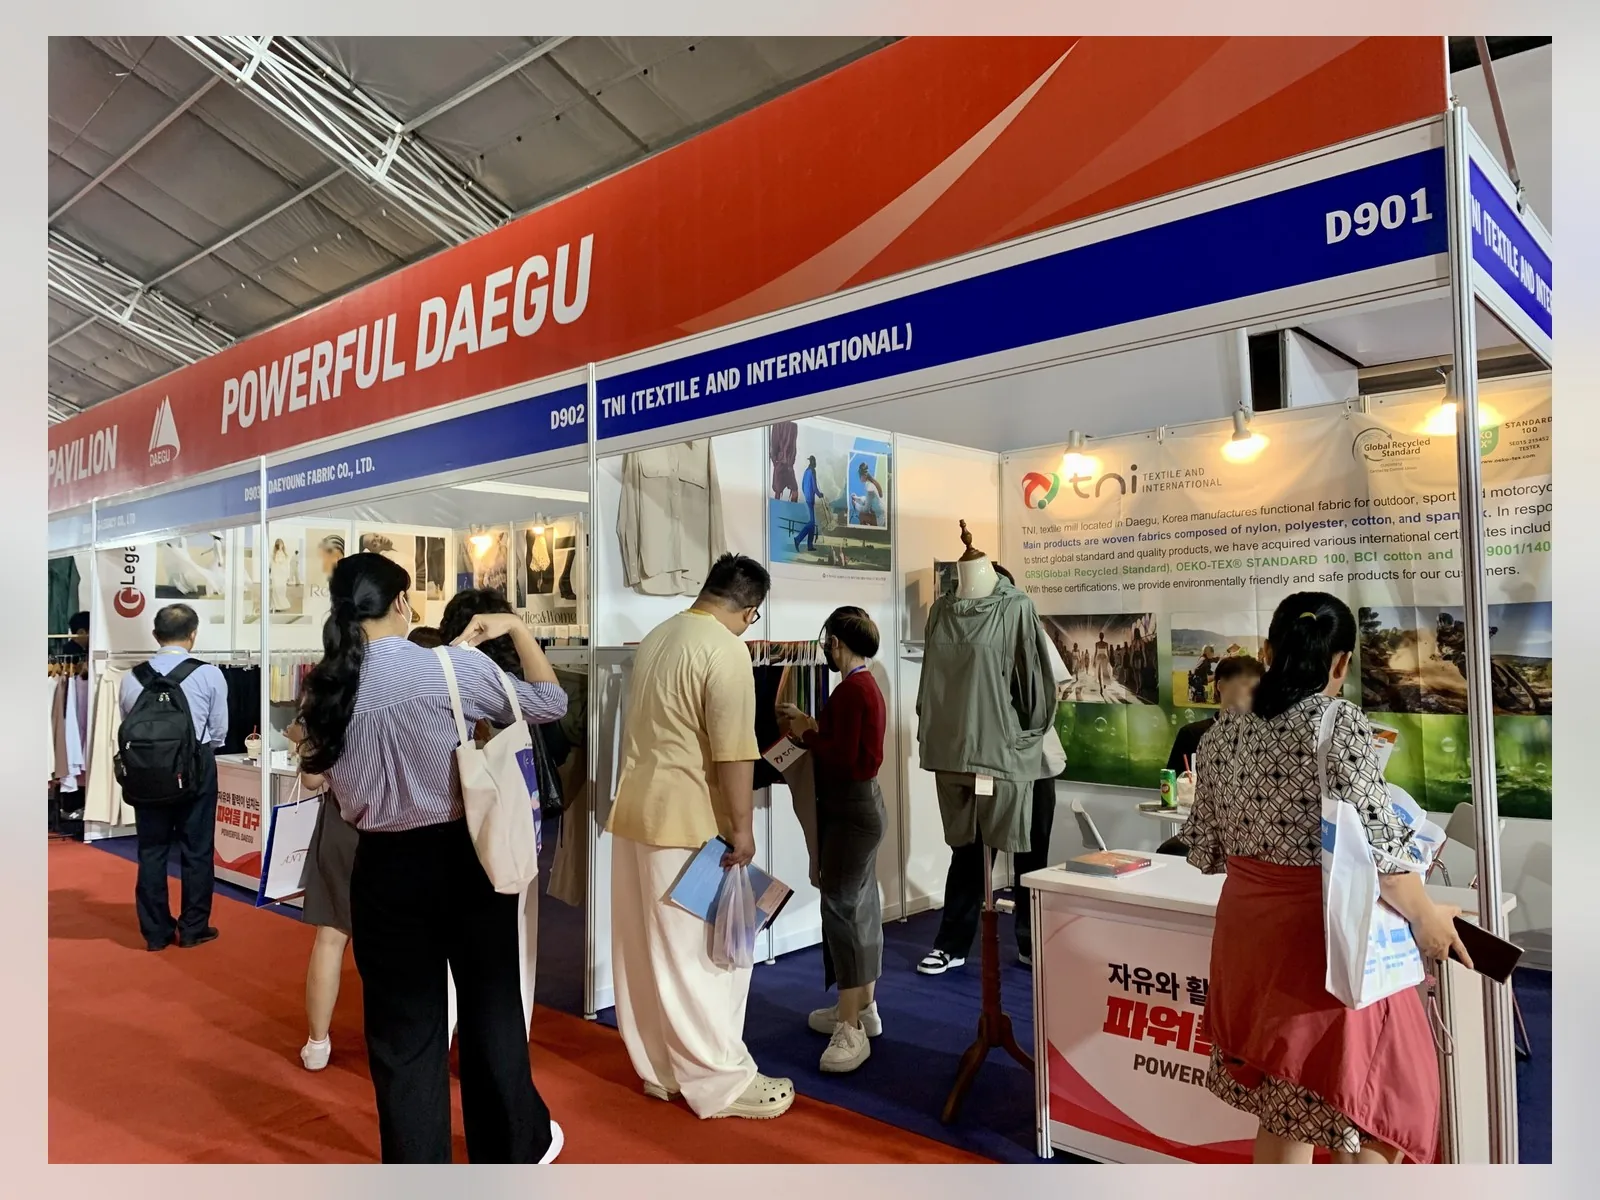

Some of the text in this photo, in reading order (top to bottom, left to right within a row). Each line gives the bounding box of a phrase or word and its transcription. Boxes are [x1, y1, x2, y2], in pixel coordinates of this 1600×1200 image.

[1325, 187, 1433, 245] D901
[1471, 193, 1482, 236] NI
[1520, 254, 1535, 295] AND
[1535, 272, 1552, 316] INTE
[220, 233, 594, 434] POWERFUL DAEGU
[602, 322, 913, 420] TNI (TEXTILE AND INTERNATIONAL)
[550, 404, 585, 430] D902
[1505, 416, 1552, 429] STANDARD
[1521, 426, 1538, 434] 100
[48, 424, 118, 488] PAVILION
[149, 449, 171, 468] DAEGU
[1364, 438, 1431, 452] Global Recycled
[1381, 447, 1421, 458] Standard
[268, 456, 375, 494] DAEYOUNG FABRIC CO., LTD.
[1069, 464, 1138, 499] tni
[1142, 477, 1222, 493] INTERNATIONAL
[1143, 467, 1205, 482] TEXTILE AND
[1022, 526, 1038, 535] TNI,
[1040, 524, 1062, 534] textile
[1064, 523, 1078, 532] mill
[1080, 520, 1113, 531] located
[1115, 520, 1122, 528] in
[1125, 517, 1160, 528] Daegu,
[1162, 514, 1188, 524] Korea
[1190, 508, 1258, 521] manufactures
[1260, 502, 1315, 515] functional
[1318, 499, 1352, 511] fabric
[1354, 498, 1370, 508] for
[1373, 496, 1419, 507] outdoor,
[1422, 491, 1457, 505] sport
[1023, 503, 1553, 550] Main products are woven fabrics composed of nylon, polyester, cotton, and spanx. In respo
[1024, 556, 1031, 565] to
[1031, 555, 1049, 564] strict
[1050, 553, 1074, 566] global
[1076, 551, 1115, 562] standard
[1117, 549, 1135, 560] and
[1136, 547, 1167, 560] quality
[1168, 544, 1213, 558] products,
[1214, 543, 1230, 553] we
[1232, 541, 1259, 552] have
[1261, 537, 1311, 551] acquired
[1313, 535, 1357, 547] various
[1359, 530, 1430, 544] international
[1510, 520, 1551, 536] includ
[1025, 540, 1551, 580] GRS(Global Recycled Standard), OEKO-TEX® STANDARD 100, BCI cotton and 9001/140
[1025, 584, 1041, 594] With
[1041, 584, 1062, 593] these
[1064, 582, 1120, 594] certifications,
[1122, 581, 1136, 590] we
[1138, 579, 1171, 591] provide
[1172, 576, 1247, 588] environmentally
[1249, 573, 1290, 587] friendly
[1292, 572, 1315, 583] and
[1318, 571, 1344, 582] safe
[1347, 569, 1400, 583] products
[1402, 568, 1417, 580] for
[1420, 569, 1441, 579] our
[217, 805, 260, 831] 파워풀 대구
[1108, 963, 1180, 1001] 자유와
